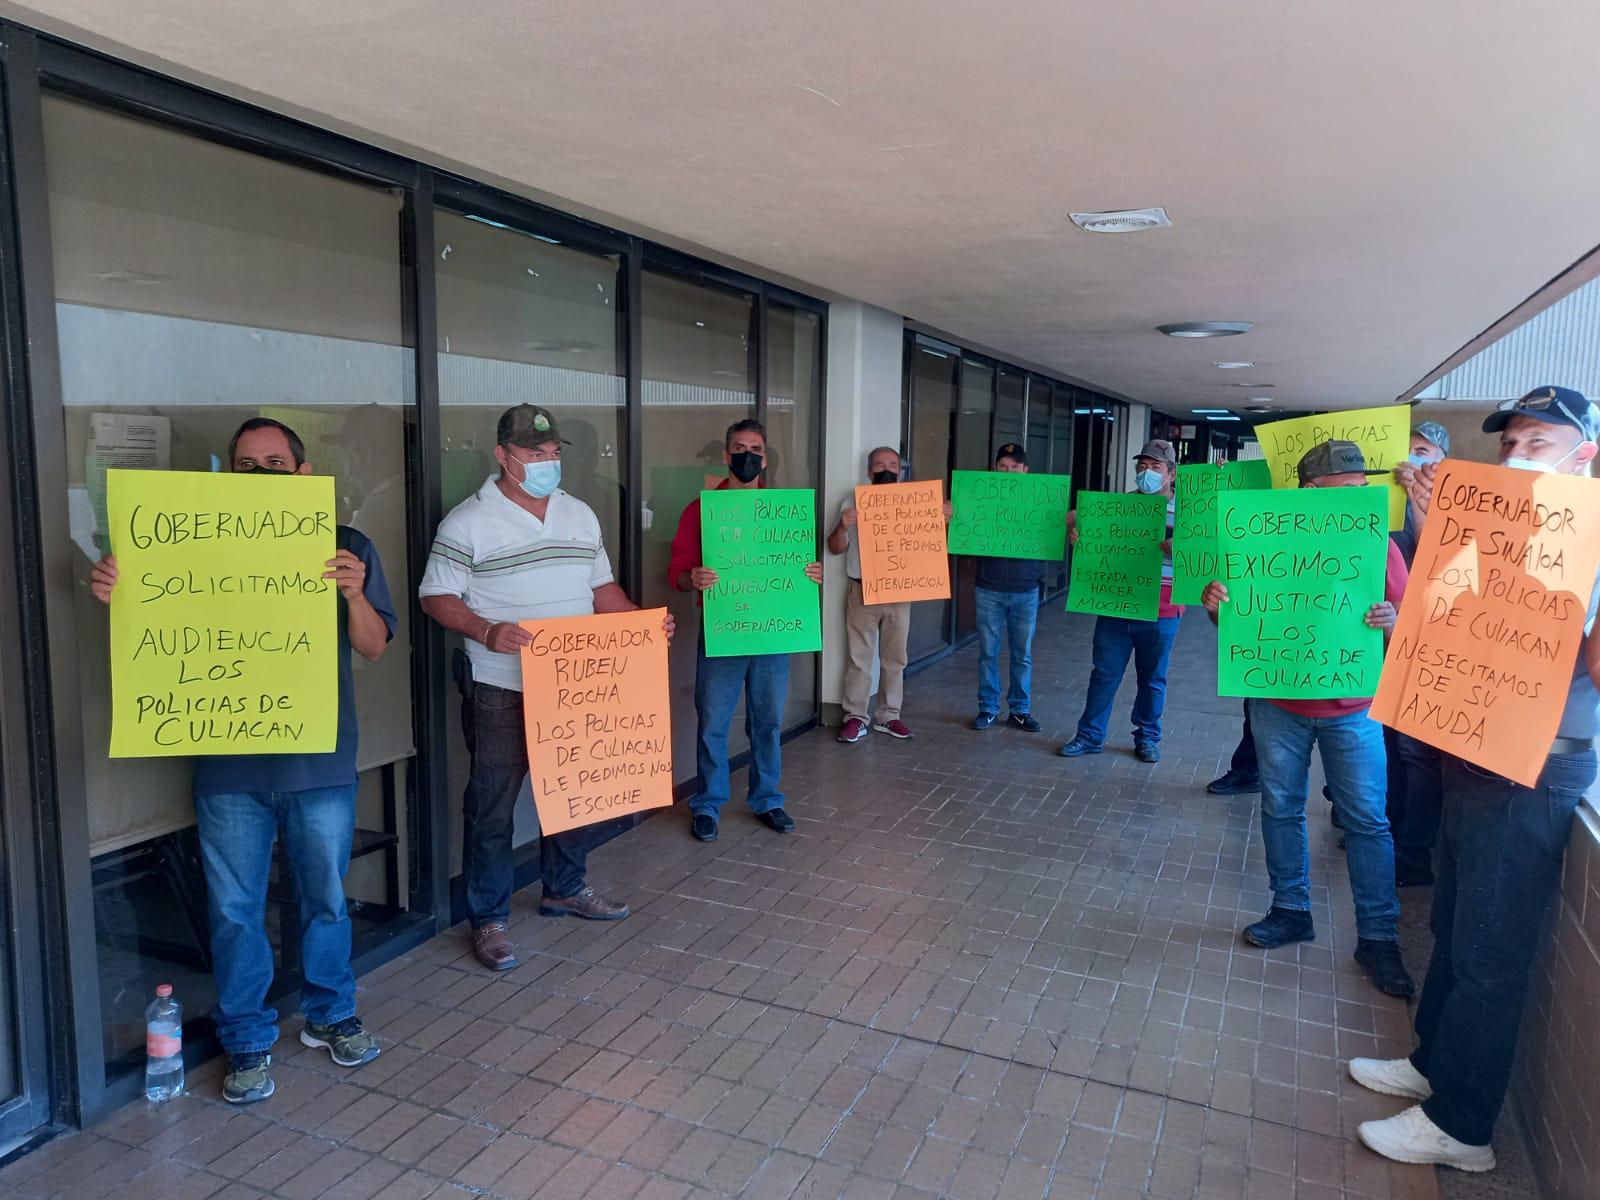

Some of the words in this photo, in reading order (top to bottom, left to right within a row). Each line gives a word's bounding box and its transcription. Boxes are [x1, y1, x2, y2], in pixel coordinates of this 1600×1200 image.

[1273, 432, 1304, 456] LOS
[1313, 425, 1392, 448] POLICIAS
[1178, 470, 1245, 496] RUBEN
[1284, 463, 1298, 481] DE
[754, 499, 808, 523] POLICIAS
[859, 490, 937, 510] GOBERNADOR
[1080, 496, 1164, 520] GOBERNADOR
[1181, 496, 1218, 518] ROC
[1437, 474, 1576, 534] GOBERNADOR
[130, 505, 333, 549] GOBERNADOR
[864, 511, 889, 522] LOS
[895, 508, 938, 523] POLICIAS
[995, 504, 1063, 528] POLICIAS
[1226, 507, 1383, 540] GOBERNADOR
[752, 527, 813, 544] CULIACAN
[873, 523, 887, 536] DE
[893, 522, 943, 535] CULIACAN
[1077, 526, 1101, 538] LOS
[1110, 523, 1160, 542] POLICIAS
[1440, 517, 1476, 546] DE
[875, 540, 893, 552] LE
[900, 541, 942, 552] PEDIMOS
[1075, 540, 1145, 556] ACUSAMOS
[716, 551, 810, 570] SOLICITAMOS
[888, 555, 907, 571] SU
[1100, 556, 1109, 570] A
[1226, 551, 1361, 581] EXIGIMOS
[141, 571, 328, 603] SOLICITAMOS
[706, 578, 795, 600] AUDIENCIA
[865, 576, 945, 594] INTERVENCION
[1076, 567, 1128, 583] ESTRADA
[1137, 576, 1152, 586] DE
[1427, 554, 1473, 588] LOS
[1482, 569, 1574, 622] POLICIAS
[1091, 582, 1136, 597] HACER
[1236, 584, 1352, 617] JUSTICIA
[735, 602, 749, 612] SR
[1076, 598, 1141, 614] MOCHES
[1427, 597, 1462, 627] DE
[714, 618, 803, 635] GOBERNADOR
[1257, 618, 1317, 645] LOS
[133, 627, 311, 661] AUDIENCIA
[531, 629, 653, 656] GOBERNADOR
[1230, 644, 1329, 665] POLICIAS
[1340, 649, 1363, 665] DE
[178, 660, 245, 684] LOS
[555, 656, 628, 686] RUBEN
[1244, 667, 1363, 689] CULIACAN
[1396, 637, 1543, 698] NESECITAMOS
[558, 684, 621, 710] ROCHA
[1417, 667, 1450, 692] DE
[1464, 685, 1498, 708] SU
[137, 692, 246, 724] POLICIAS
[260, 695, 293, 713] DE
[155, 718, 303, 746] CULIACAN
[536, 720, 575, 744] LOS
[586, 713, 657, 738] POLICIAS
[1401, 693, 1486, 751] AYUDA
[557, 746, 579, 767] DE
[590, 736, 666, 760] CULIACAN
[542, 776, 568, 796] LE
[578, 762, 645, 789] PEDIMOS
[568, 789, 641, 819] ESCUCHE
